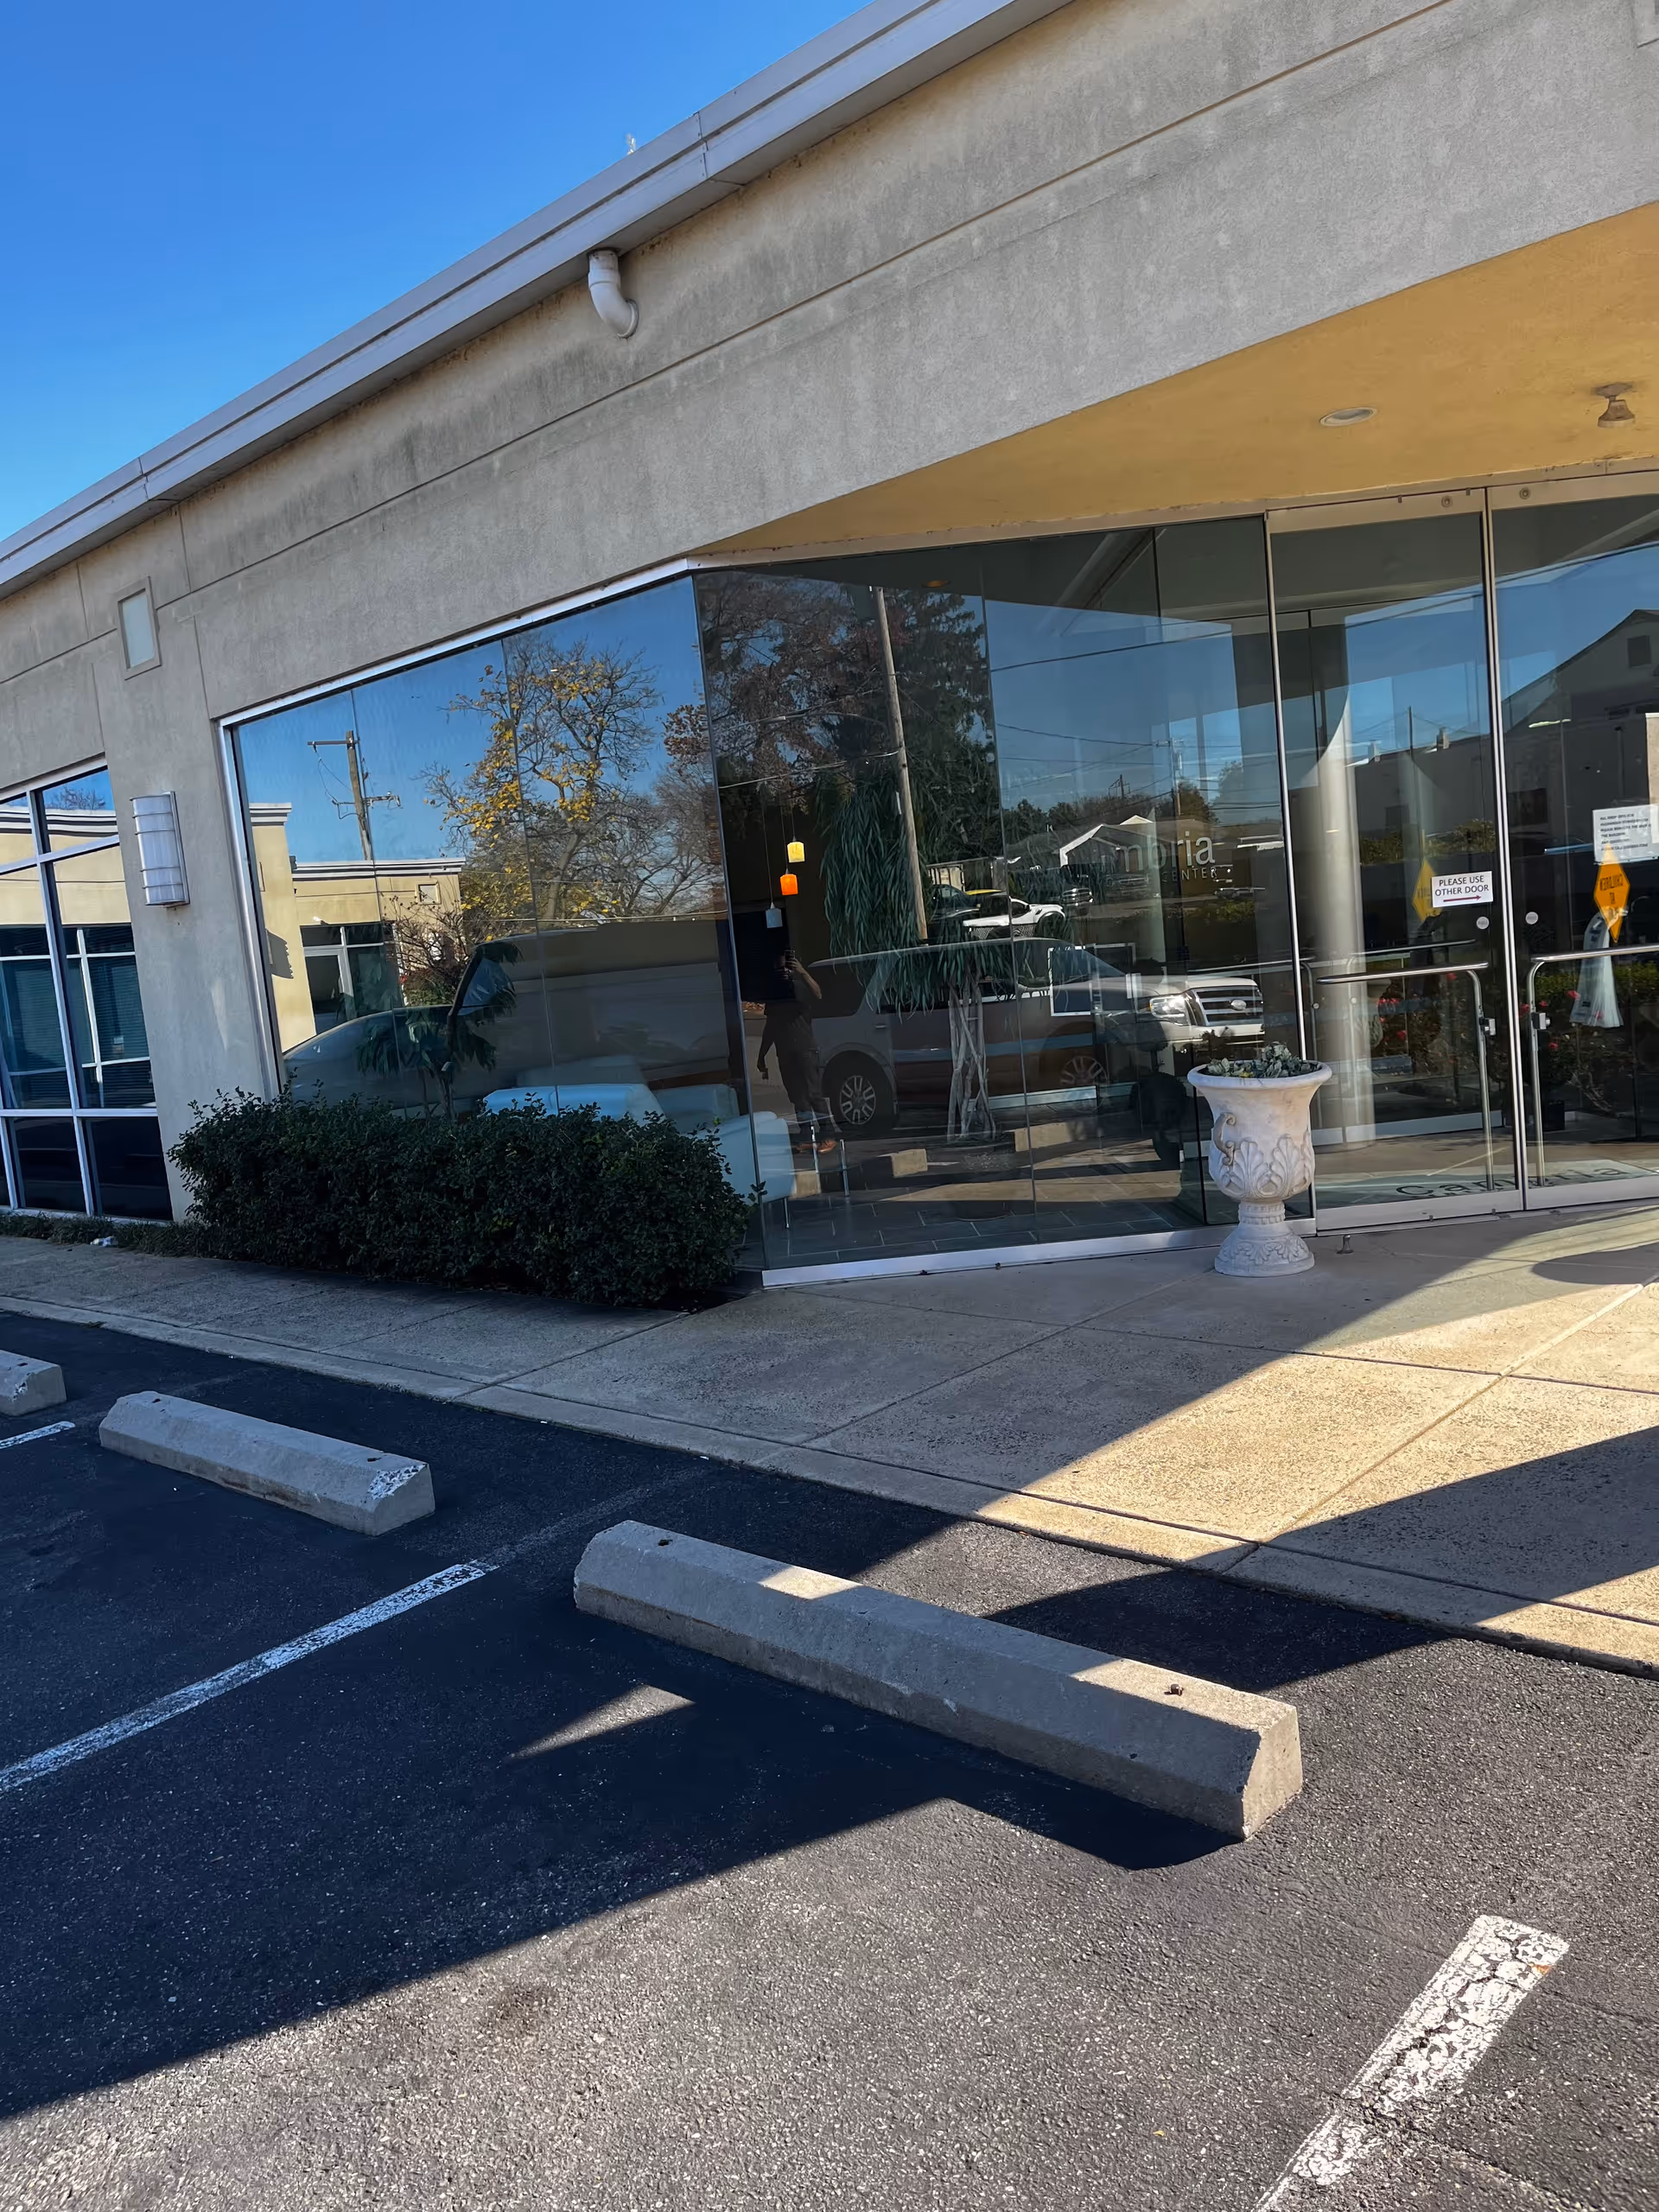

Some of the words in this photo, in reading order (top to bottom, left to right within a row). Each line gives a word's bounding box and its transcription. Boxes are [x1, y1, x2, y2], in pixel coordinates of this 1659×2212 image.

[1161, 867, 1218, 882] CENTER
[1439, 877, 1466, 887] PLEASE
[1470, 875, 1484, 884] USE
[1435, 887, 1462, 896] OTHER
[1465, 884, 1489, 893] DOOR
